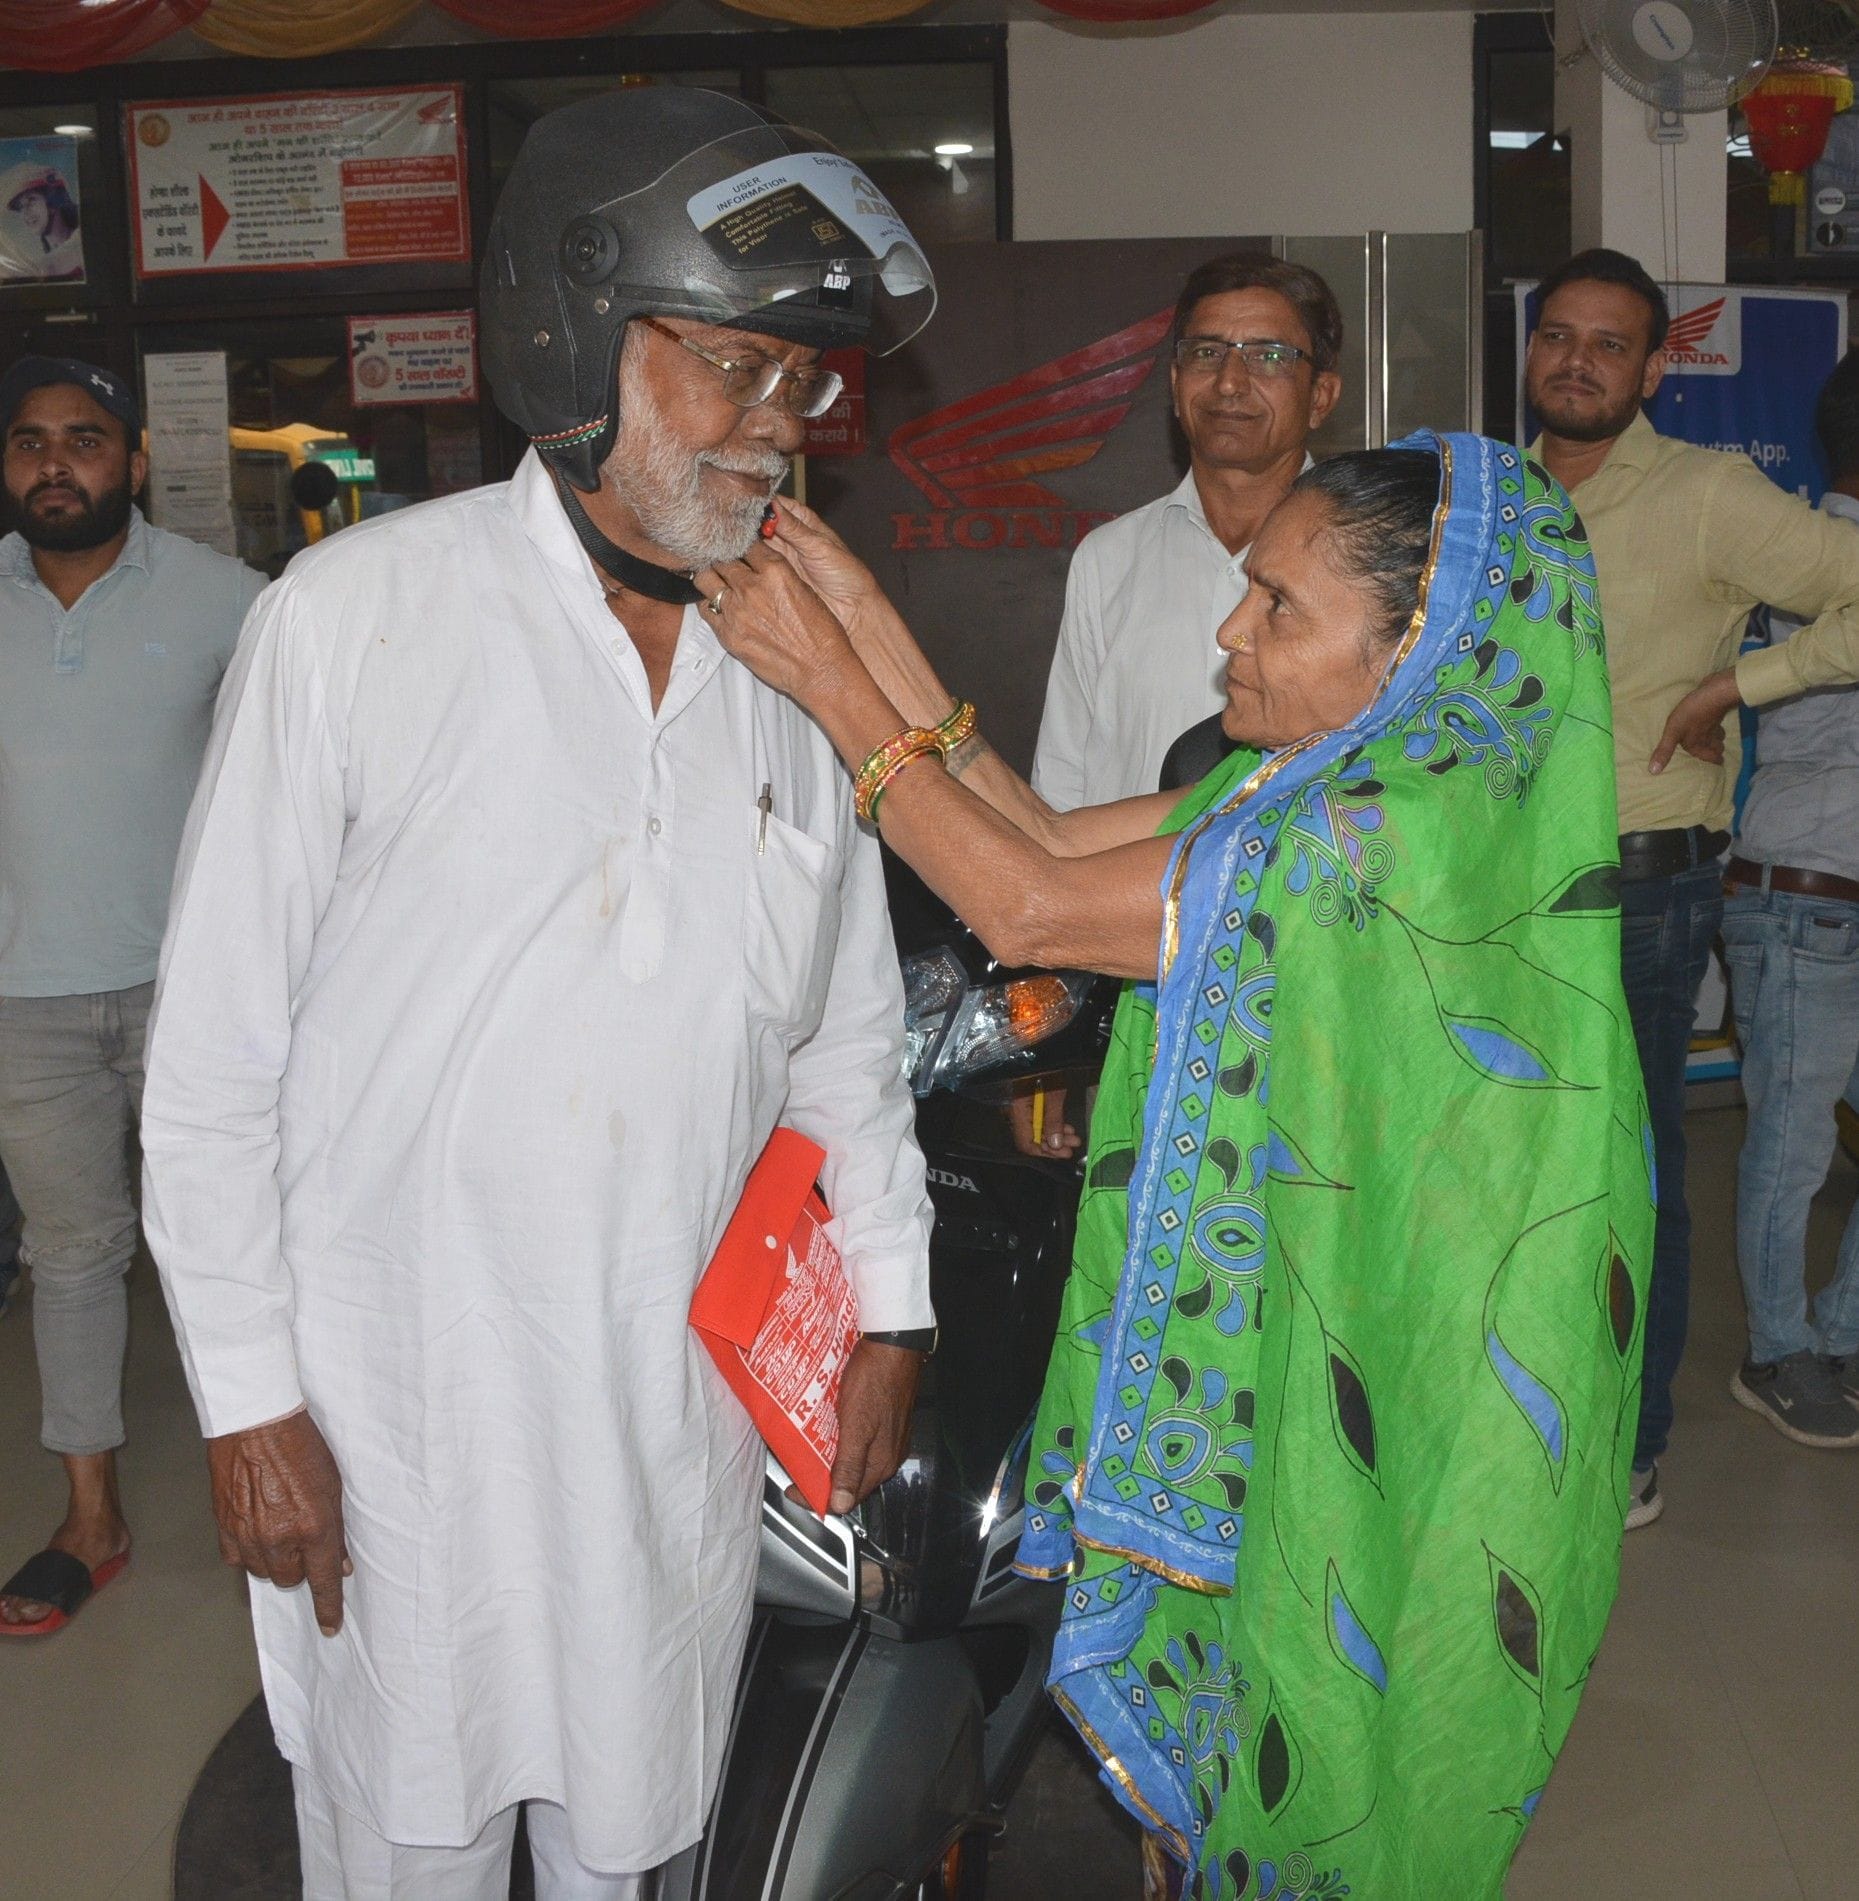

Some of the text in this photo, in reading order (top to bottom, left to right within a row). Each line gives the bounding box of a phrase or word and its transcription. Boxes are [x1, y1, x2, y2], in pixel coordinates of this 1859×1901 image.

[716, 177, 788, 212] INFORMATION
[732, 177, 761, 194] USER
[720, 223, 727, 231] A
[726, 215, 744, 226] High
[744, 201, 771, 217] Quality
[725, 212, 768, 239] Comfortable
[731, 234, 747, 246] This
[738, 234, 768, 255] for Visor
[823, 273, 850, 291] ABP
[395, 368, 404, 381] 5
[1749, 439, 1791, 467] App.
[890, 511, 1120, 552] HON
[926, 1167, 981, 1194] NDA
[794, 1398, 817, 1422] R.
[816, 1368, 833, 1389] S.
[831, 1289, 857, 1358] Honda
